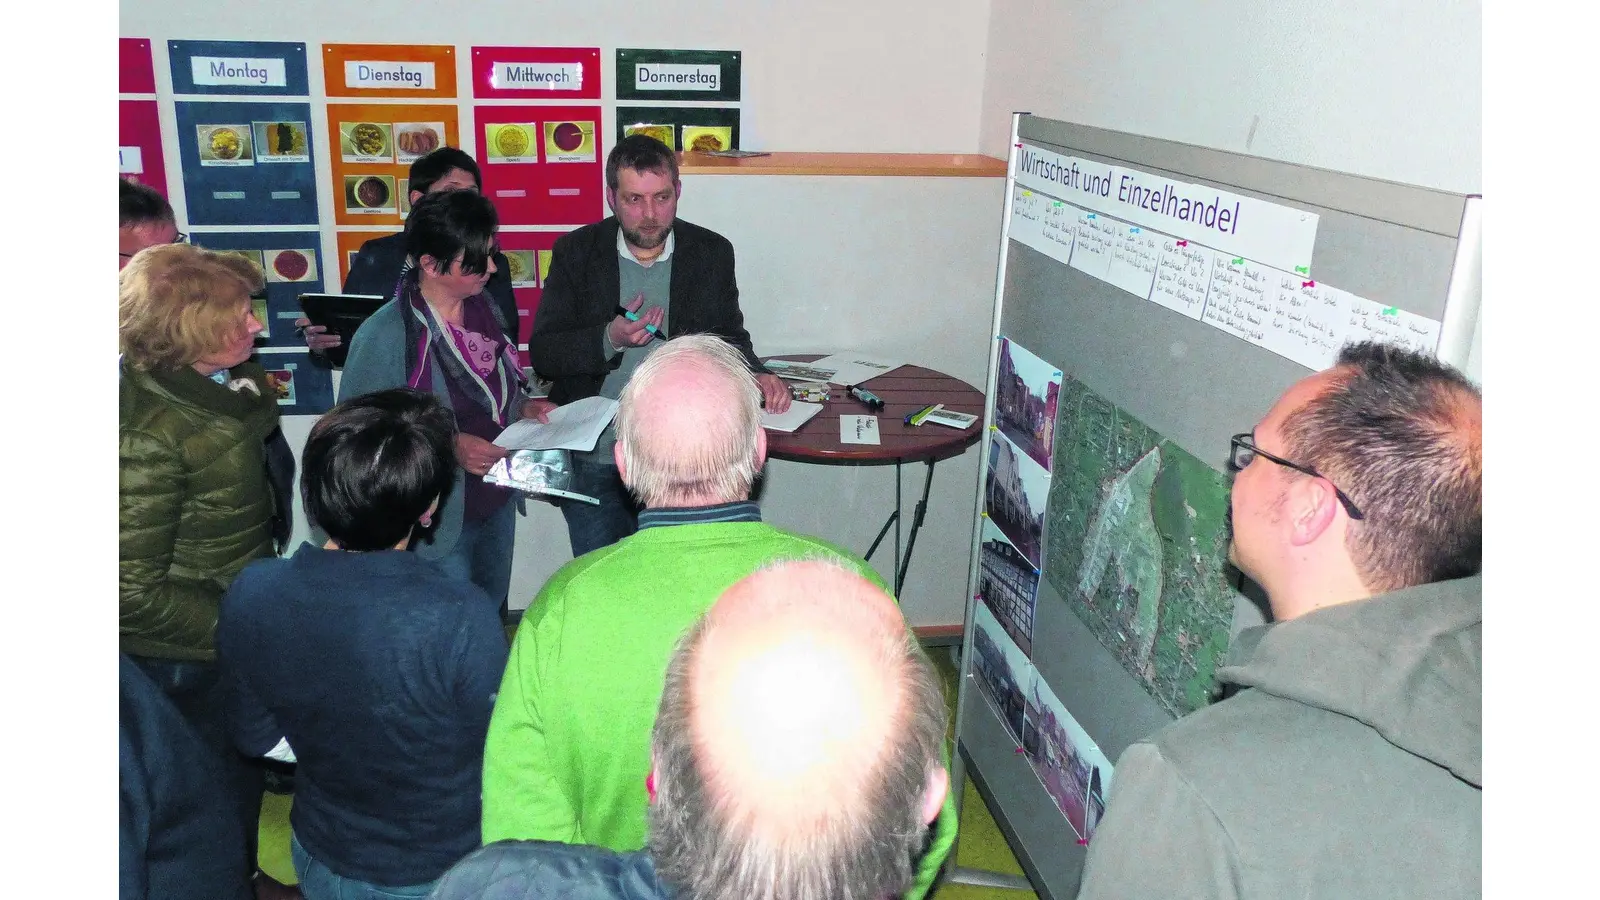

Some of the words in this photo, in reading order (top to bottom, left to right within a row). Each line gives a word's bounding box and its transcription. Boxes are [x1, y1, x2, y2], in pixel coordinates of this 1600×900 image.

[210, 61, 268, 84] Montag
[358, 65, 422, 87] Dienstag
[506, 66, 570, 83] Mittwoch
[639, 67, 717, 89] Donnerstag
[1020, 149, 1080, 189] Wirtschaft
[1083, 171, 1112, 198] und
[1118, 175, 1240, 235] Einzelhandel
